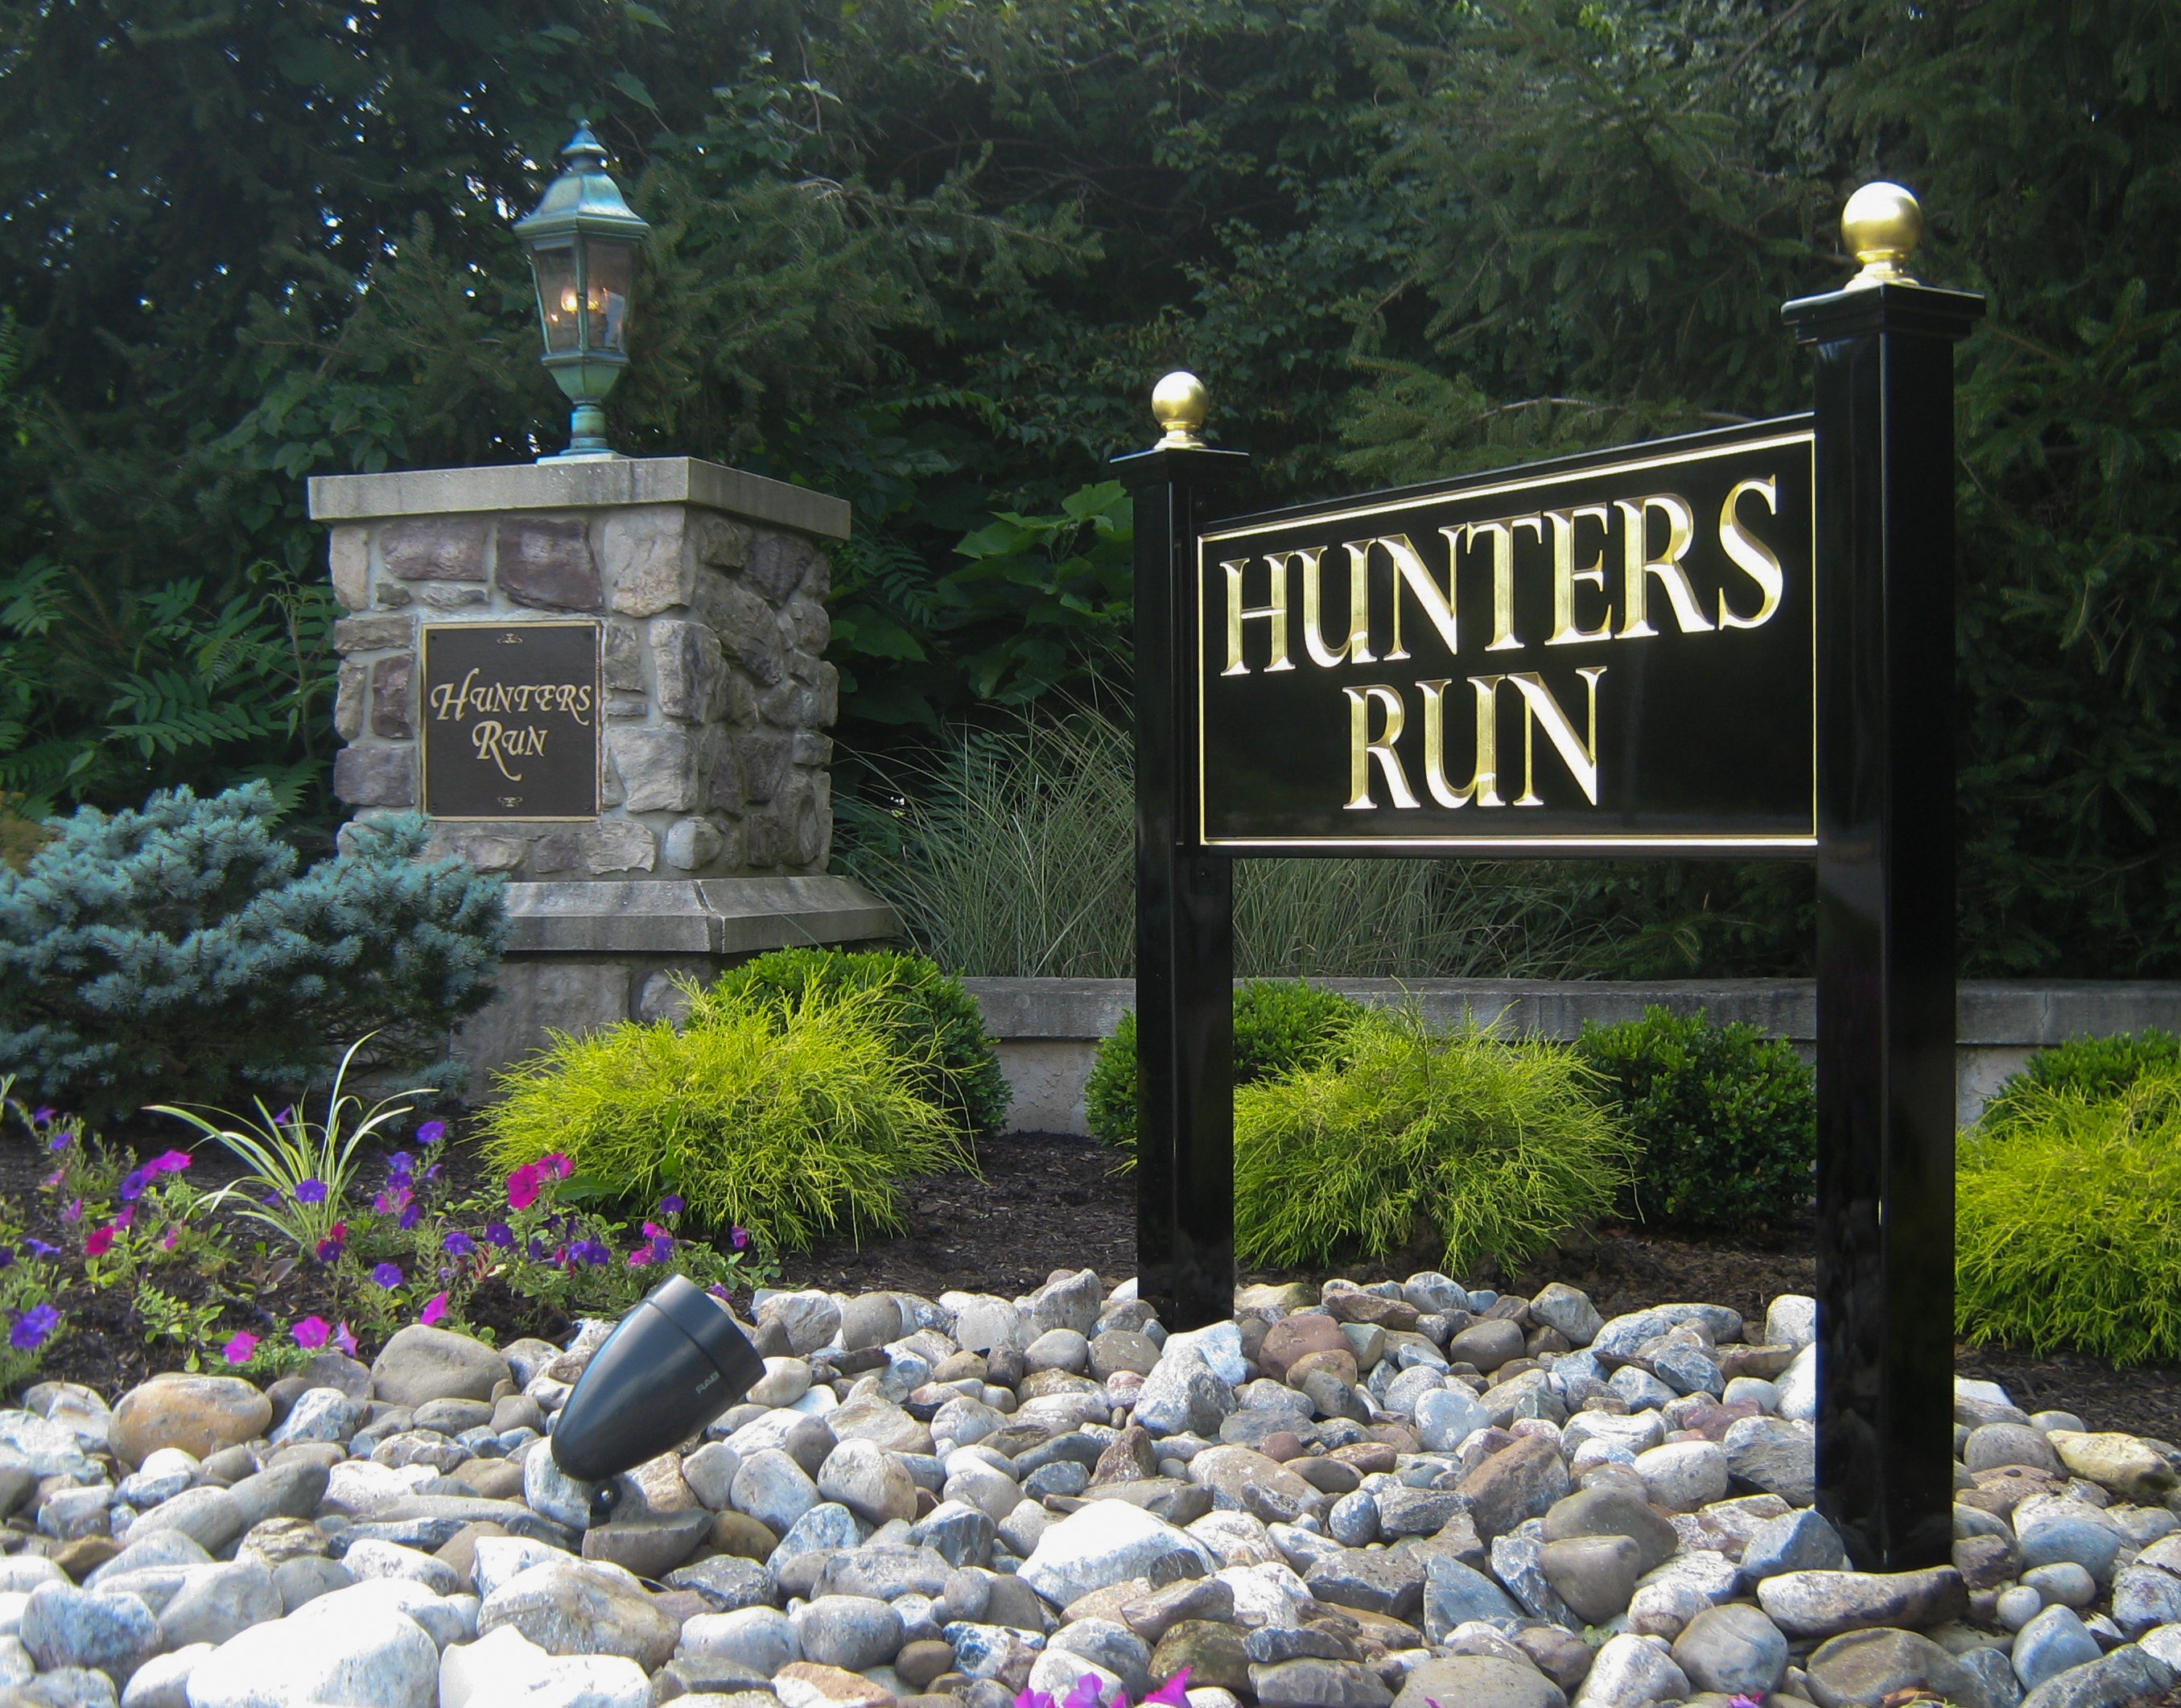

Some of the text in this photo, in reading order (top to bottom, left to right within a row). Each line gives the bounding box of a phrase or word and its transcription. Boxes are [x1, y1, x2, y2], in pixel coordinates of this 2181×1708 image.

[1218, 474, 1784, 676] HUNTERS
[1342, 665, 1607, 810] RUN
[695, 1371, 720, 1394] RAB
